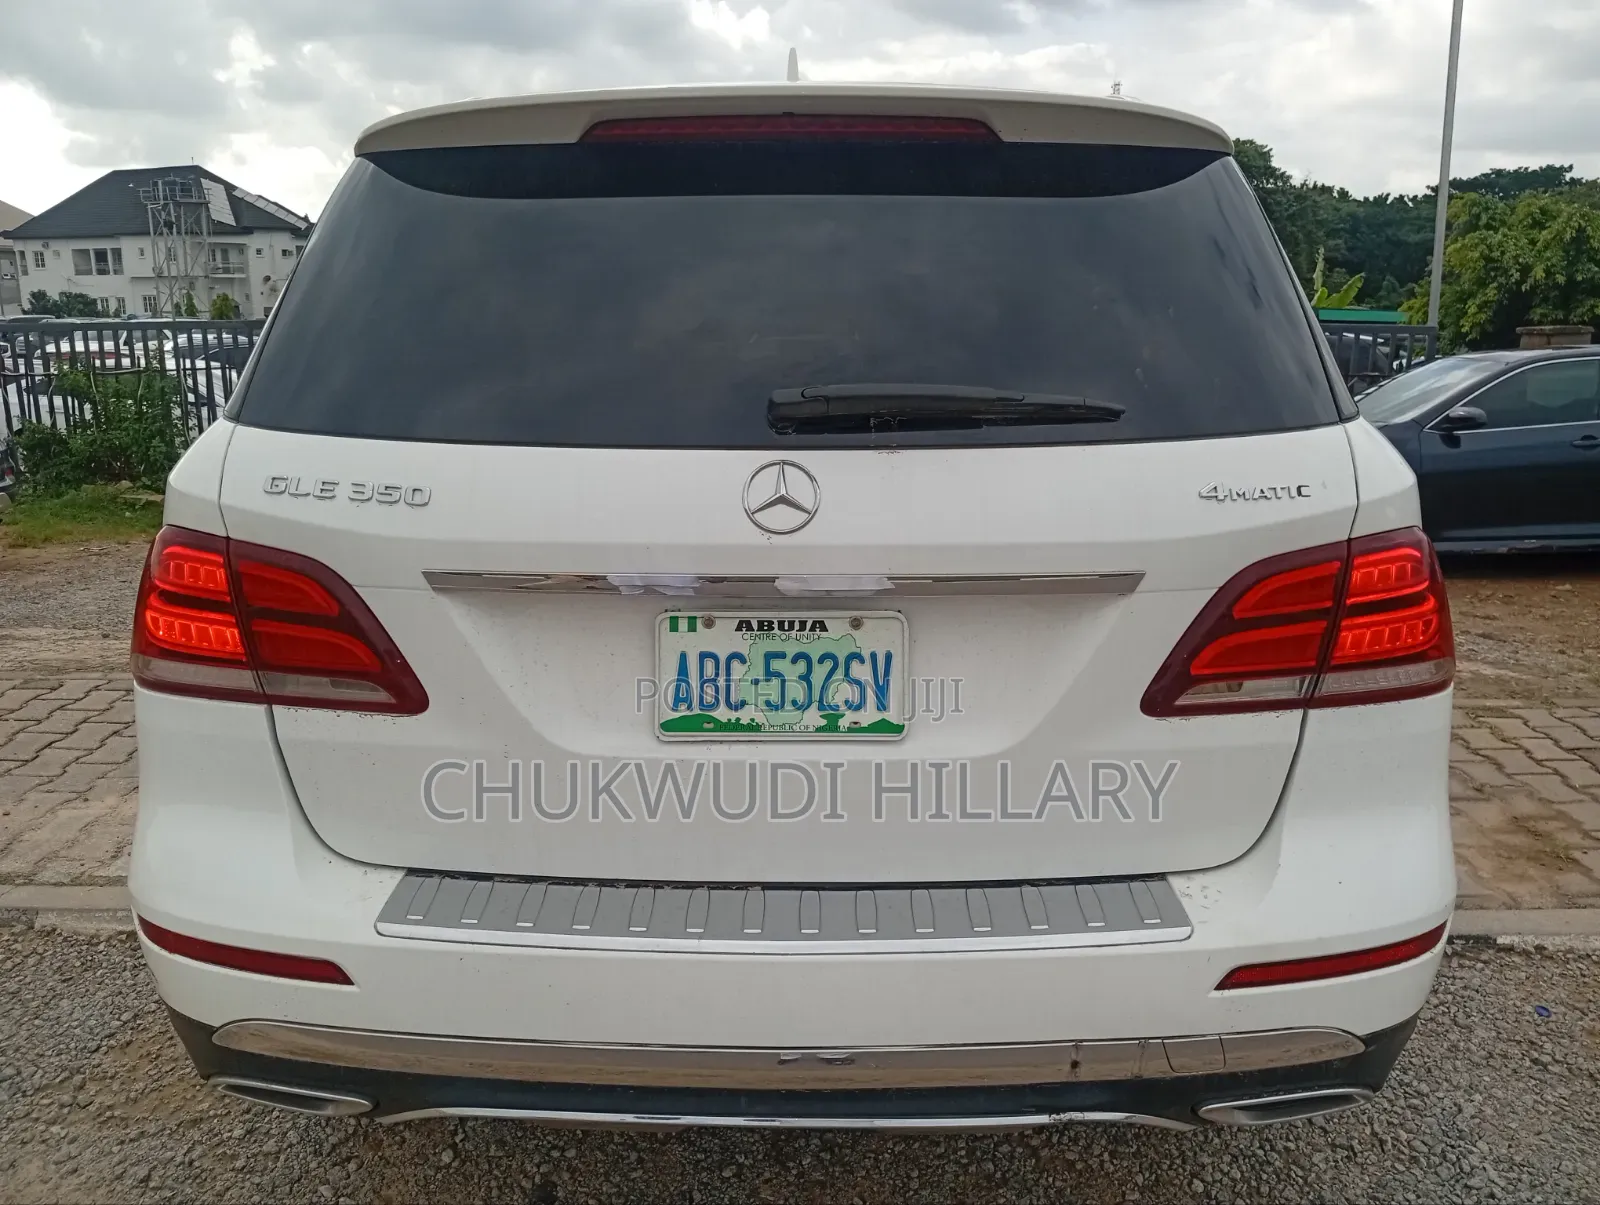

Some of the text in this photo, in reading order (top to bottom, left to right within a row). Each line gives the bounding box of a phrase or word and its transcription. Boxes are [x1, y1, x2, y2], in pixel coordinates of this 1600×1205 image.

[263, 475, 432, 506] GLE 350
[1198, 481, 1311, 502] 4MATIC
[735, 619, 829, 632] ABUJA
[741, 632, 822, 641] CENTRE OF UNITY
[760, 723, 797, 732] REPUBLIC
[799, 724, 811, 732] OF
